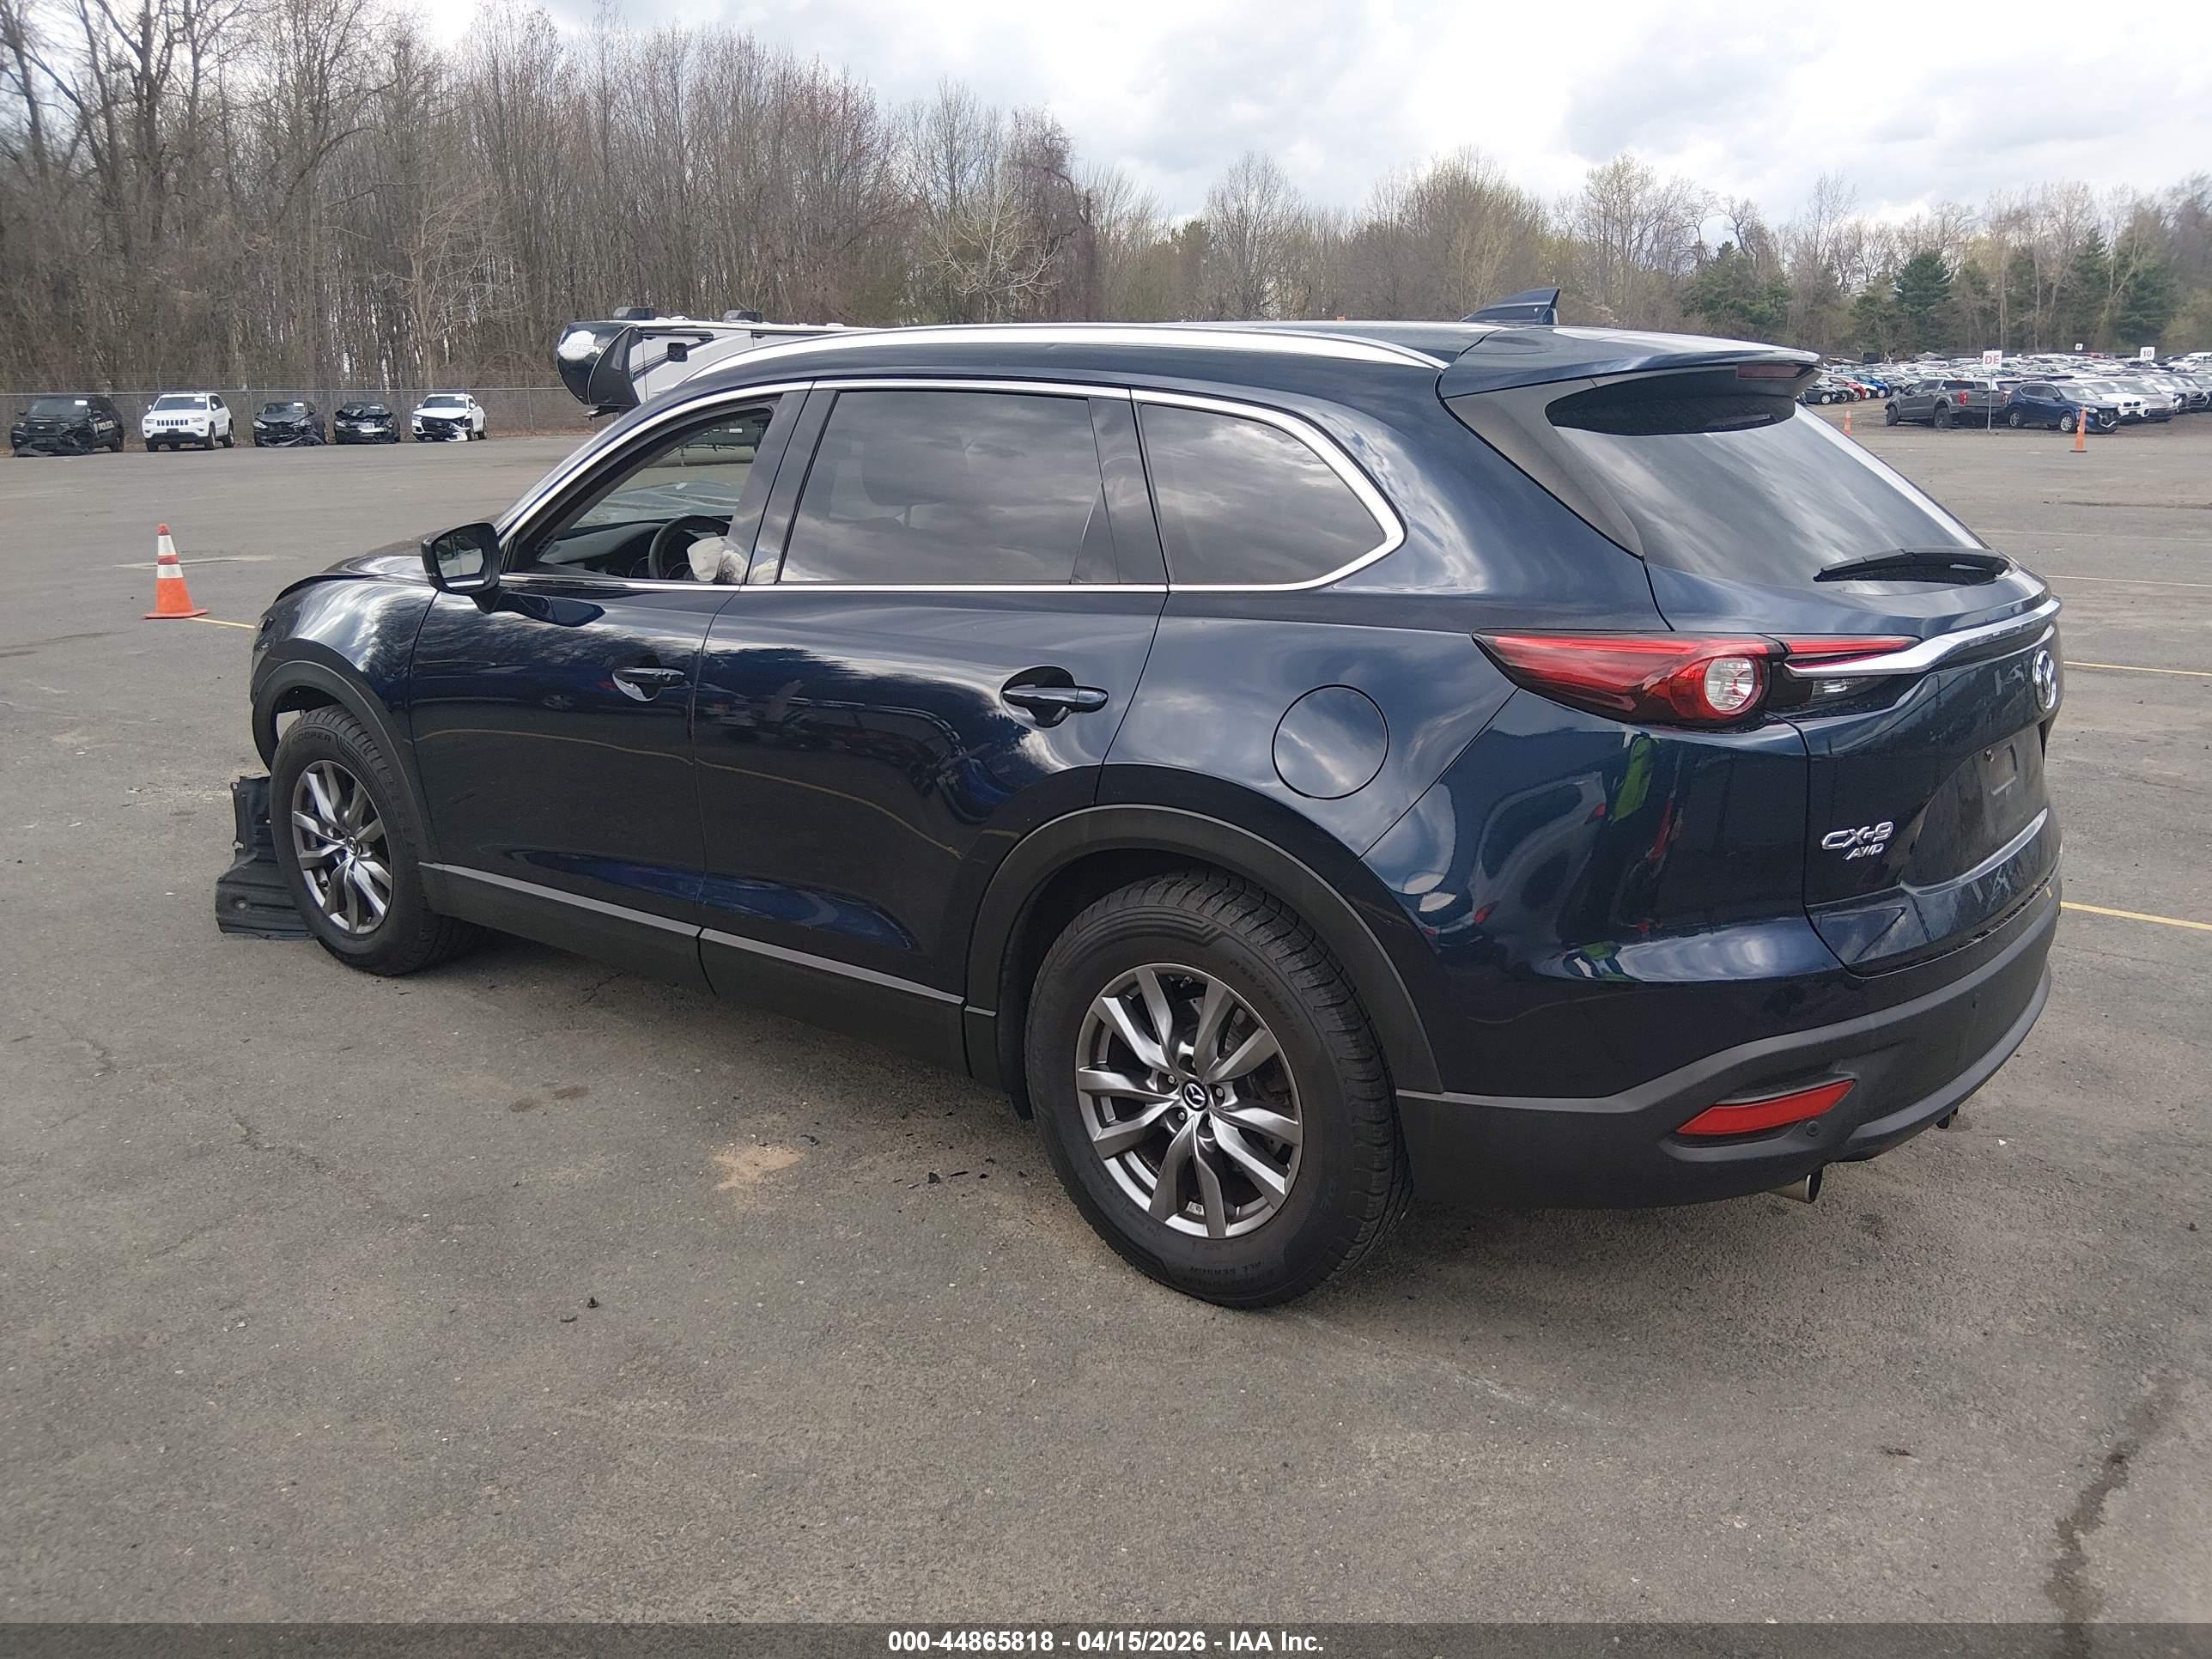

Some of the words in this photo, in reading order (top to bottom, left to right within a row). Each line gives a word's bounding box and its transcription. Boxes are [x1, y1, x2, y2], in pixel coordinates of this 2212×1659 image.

[1984, 355, 2000, 365] DE
[1820, 821, 1894, 850] CX-9
[1844, 843, 1885, 860] AWD
